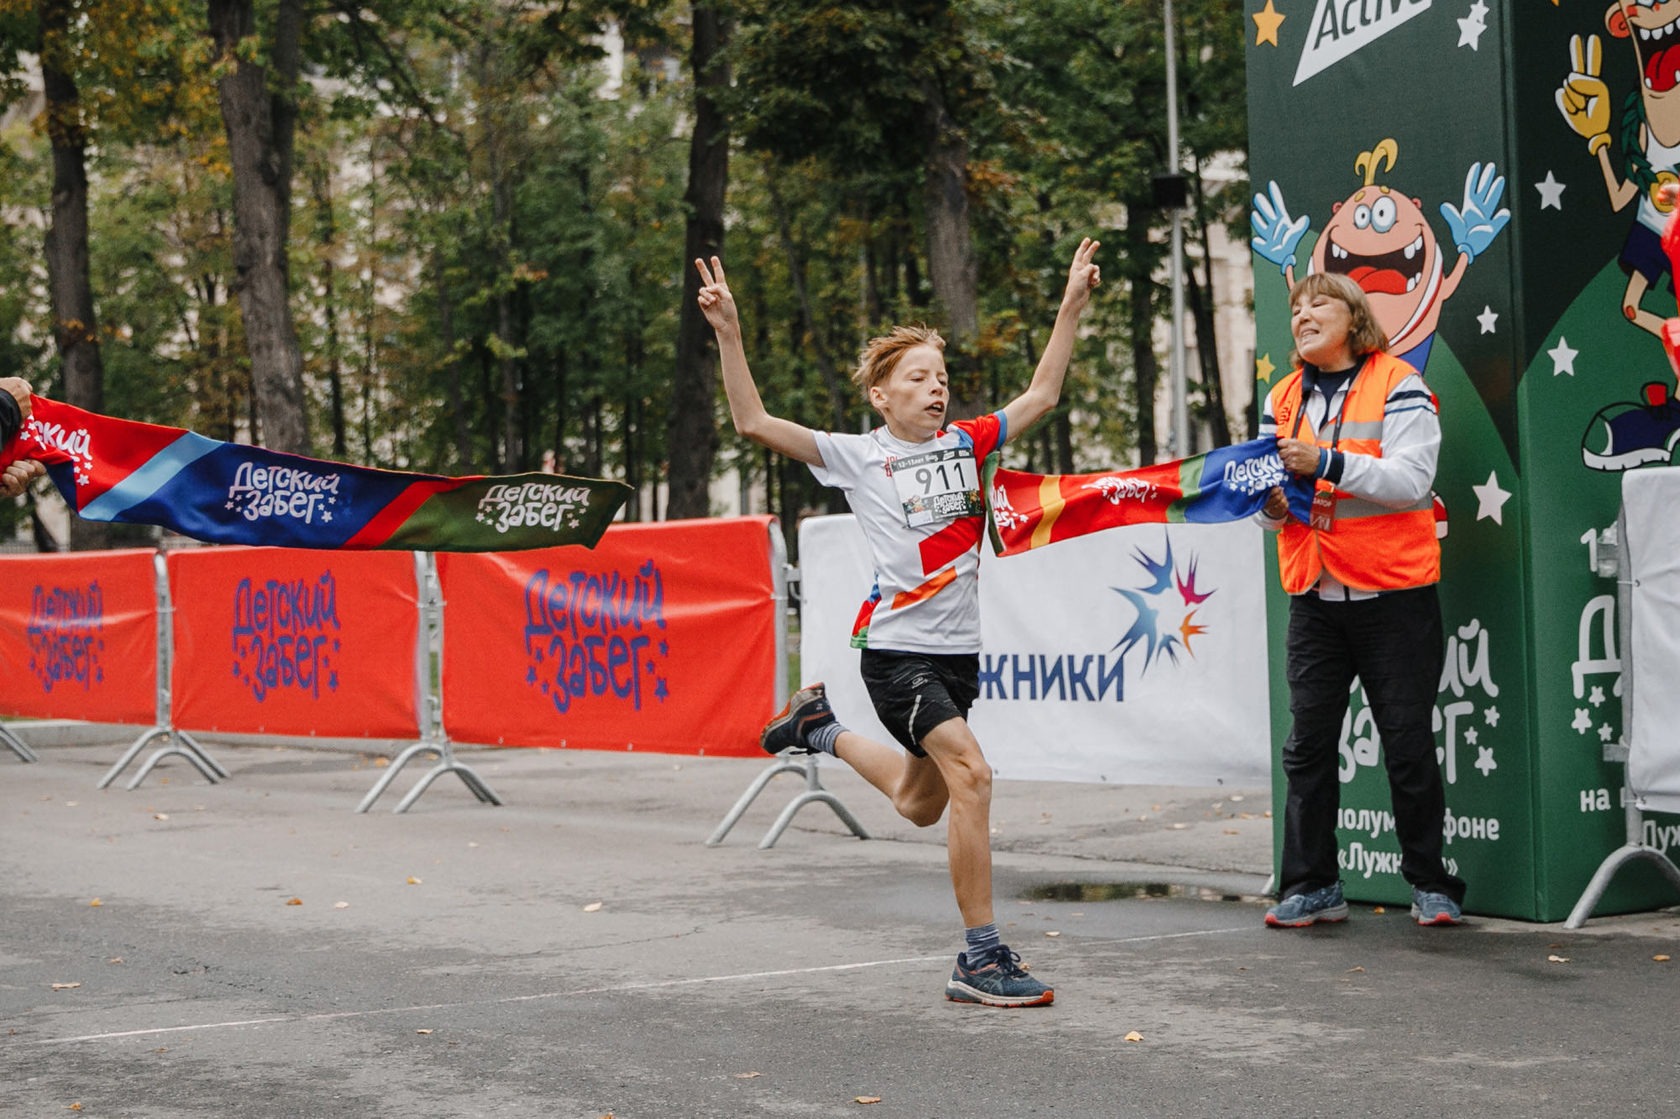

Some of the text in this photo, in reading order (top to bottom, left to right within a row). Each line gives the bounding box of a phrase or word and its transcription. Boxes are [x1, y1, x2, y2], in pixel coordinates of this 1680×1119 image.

[228, 462, 340, 498] Детский
[478, 482, 591, 509] Детский
[915, 462, 966, 495] 911
[243, 490, 324, 524] забег
[495, 502, 575, 533] забег
[232, 569, 340, 651] Детский
[524, 559, 667, 655] Детский
[250, 636, 327, 702] забег
[549, 635, 650, 714] забег
[978, 654, 1125, 702] ЖНИКИ
[1580, 788, 1611, 812] на
